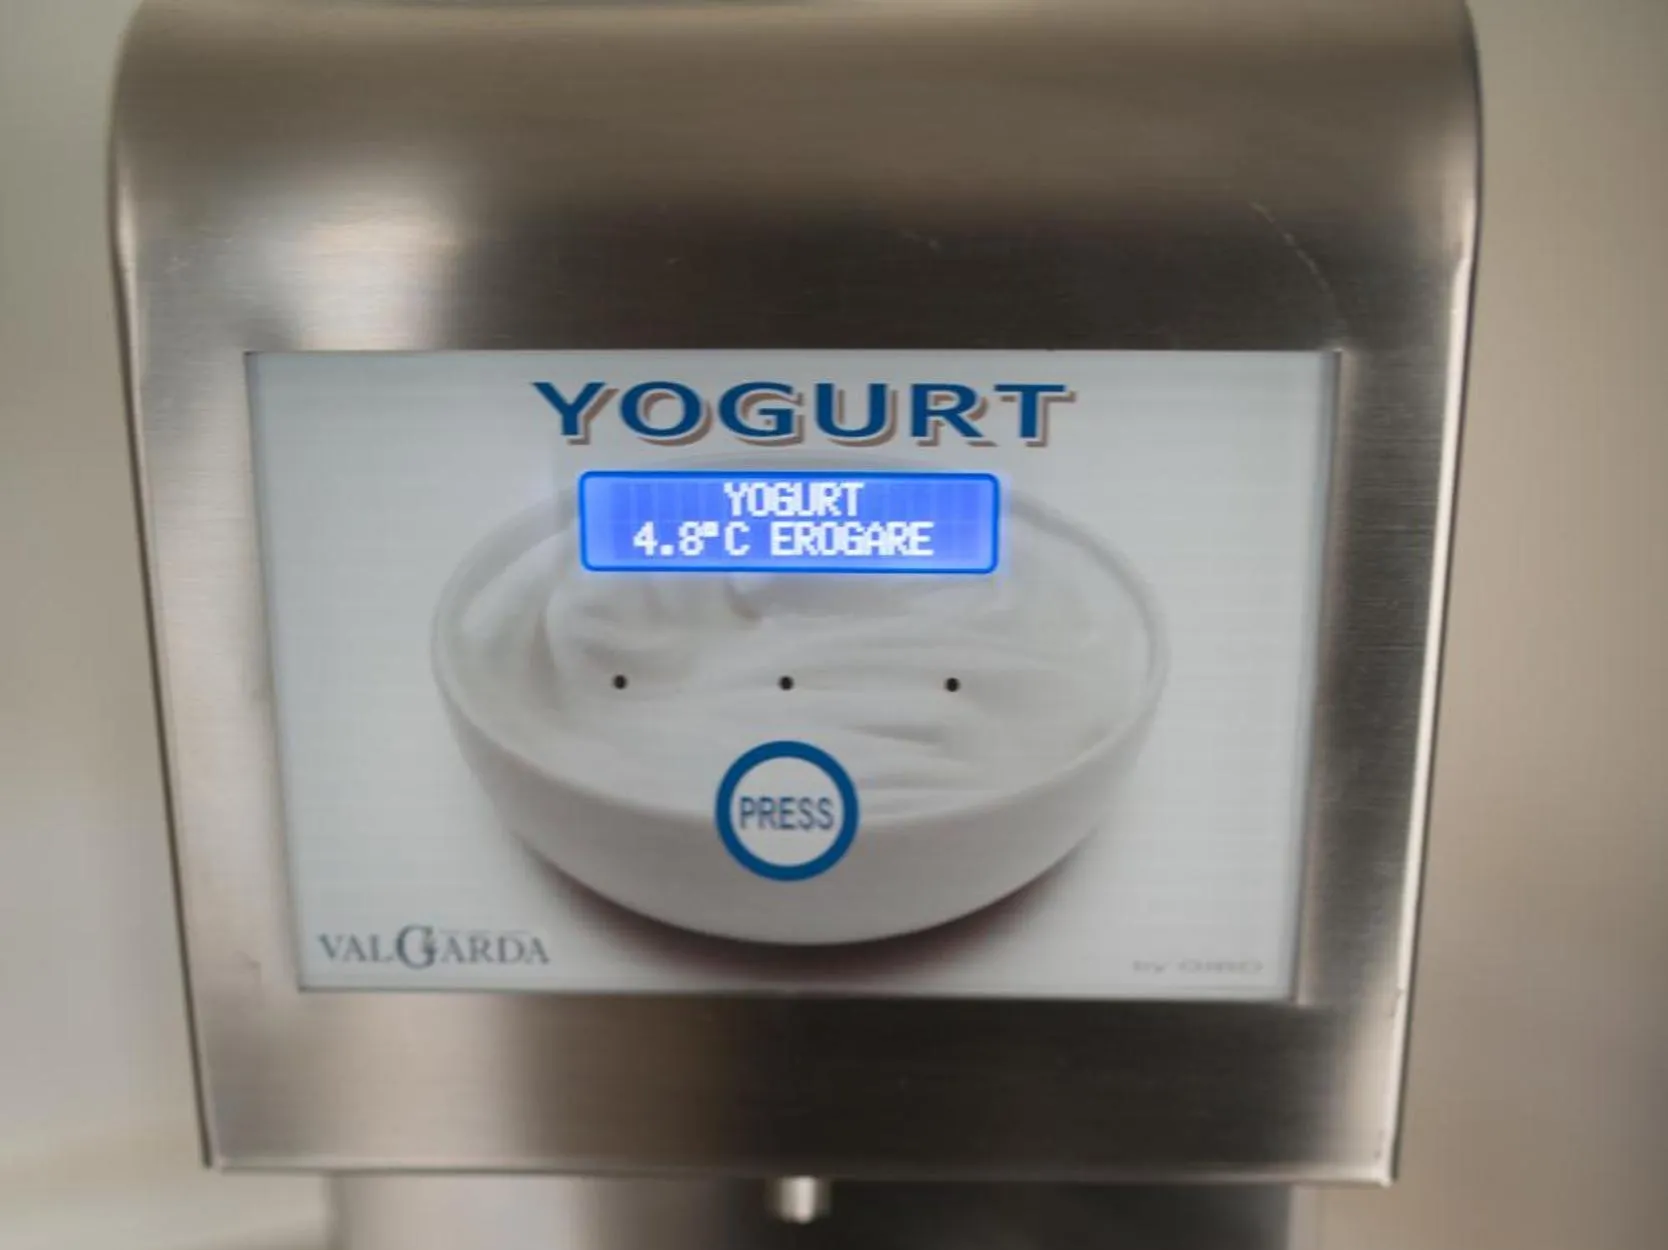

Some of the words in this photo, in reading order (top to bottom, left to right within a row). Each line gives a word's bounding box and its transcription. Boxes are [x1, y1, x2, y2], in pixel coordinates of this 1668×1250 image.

[530, 381, 1075, 446] YOGURT
[723, 481, 864, 517] YOGURT
[770, 520, 935, 557] EROGARE
[739, 796, 834, 831] PRESS
